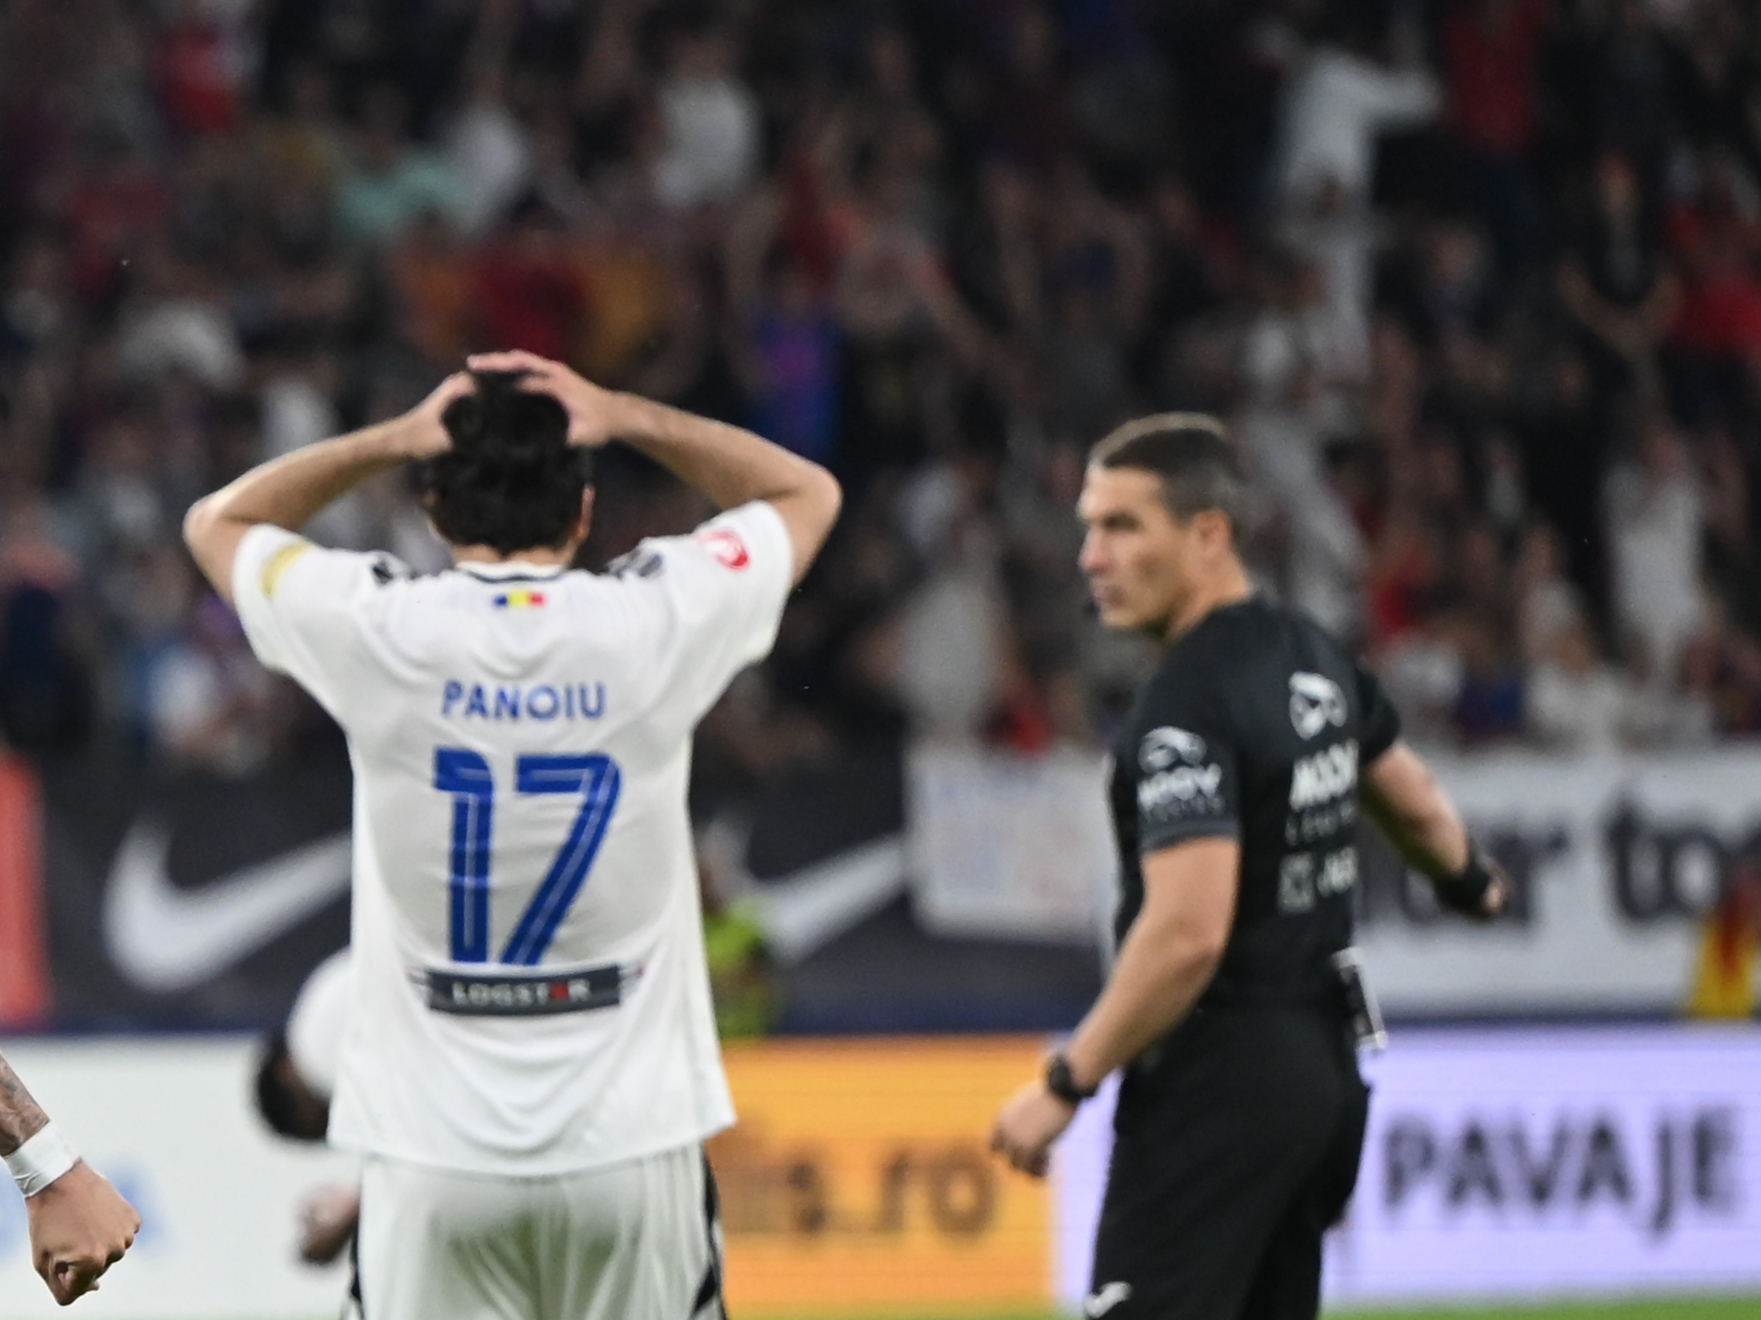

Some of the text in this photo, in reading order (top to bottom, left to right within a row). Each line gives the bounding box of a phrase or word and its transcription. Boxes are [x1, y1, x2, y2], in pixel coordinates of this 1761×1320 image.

[442, 680, 607, 722] PANOIU
[432, 746, 623, 967] 17
[1382, 1105, 1740, 1245] PAVAJE
